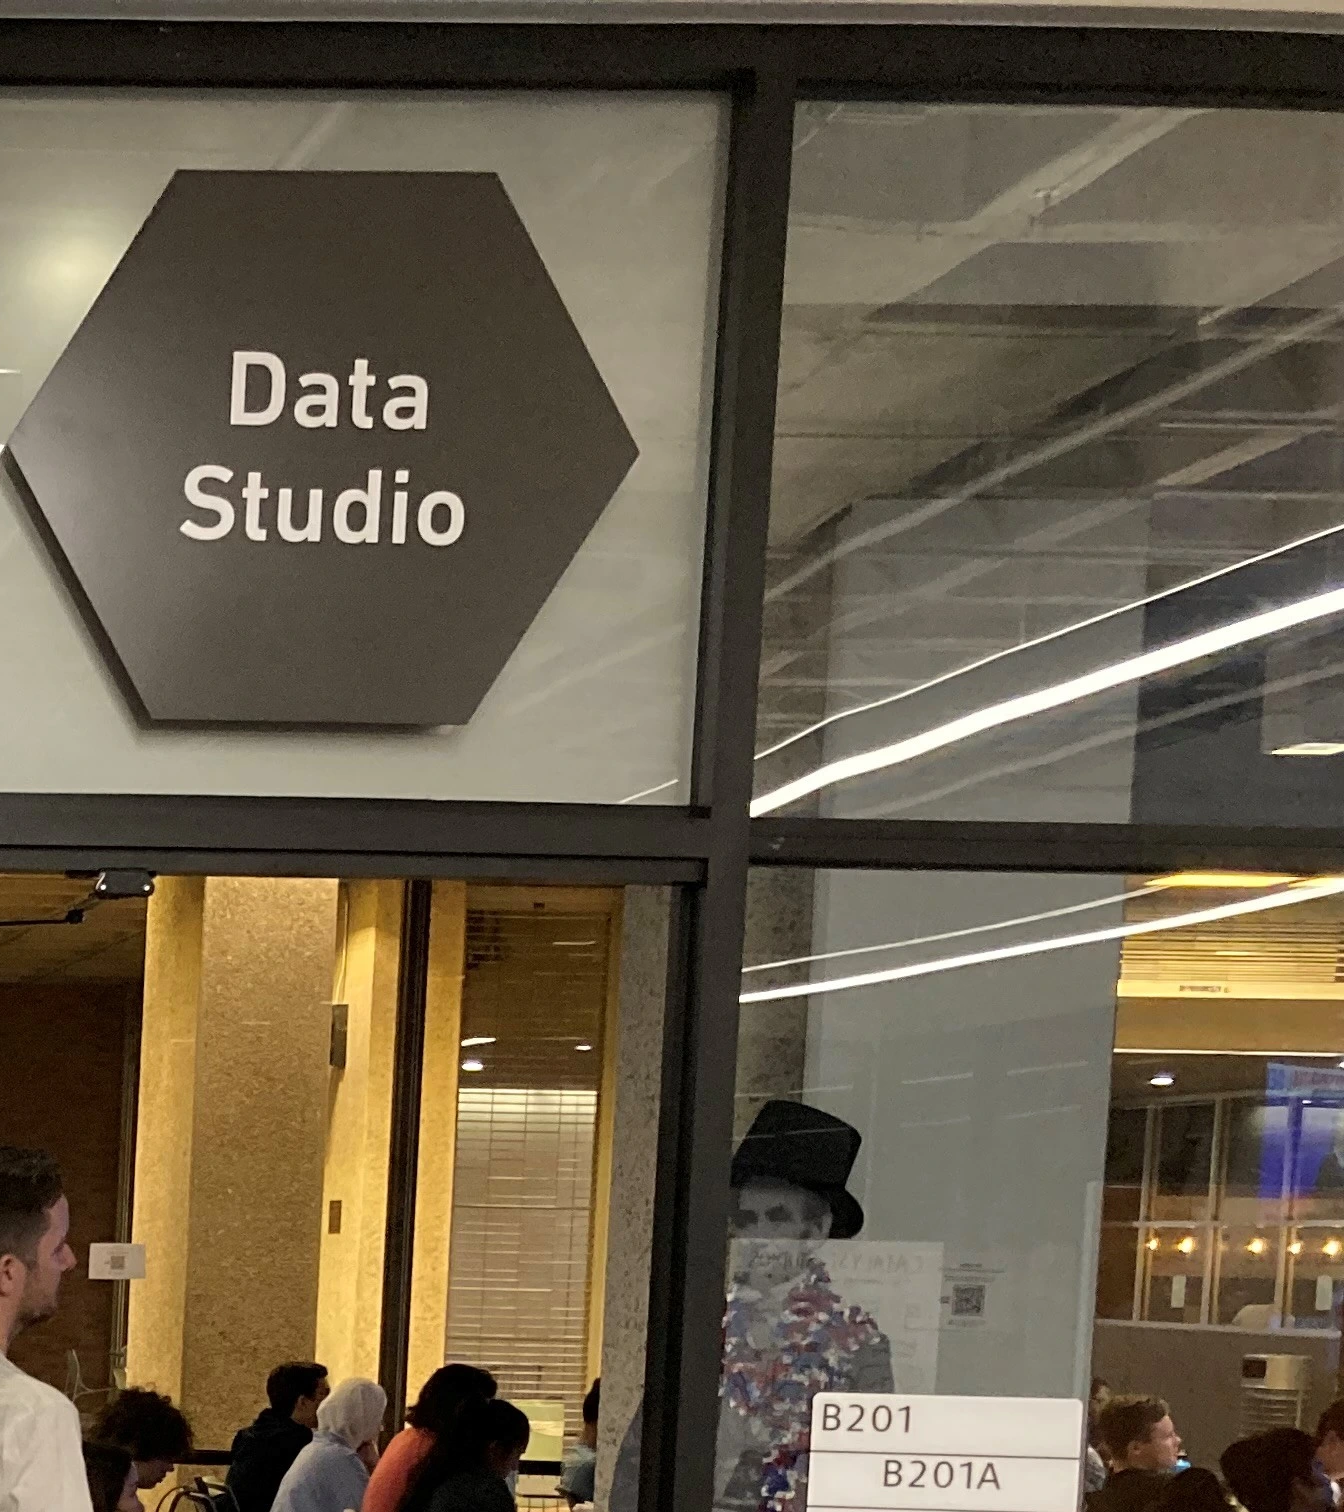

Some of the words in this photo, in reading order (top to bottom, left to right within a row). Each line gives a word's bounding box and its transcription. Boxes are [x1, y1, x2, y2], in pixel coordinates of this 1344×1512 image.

[229, 350, 429, 431] Data
[179, 464, 465, 547] Studio
[822, 1403, 912, 1433] B201
[883, 1459, 1001, 1489] B201A
